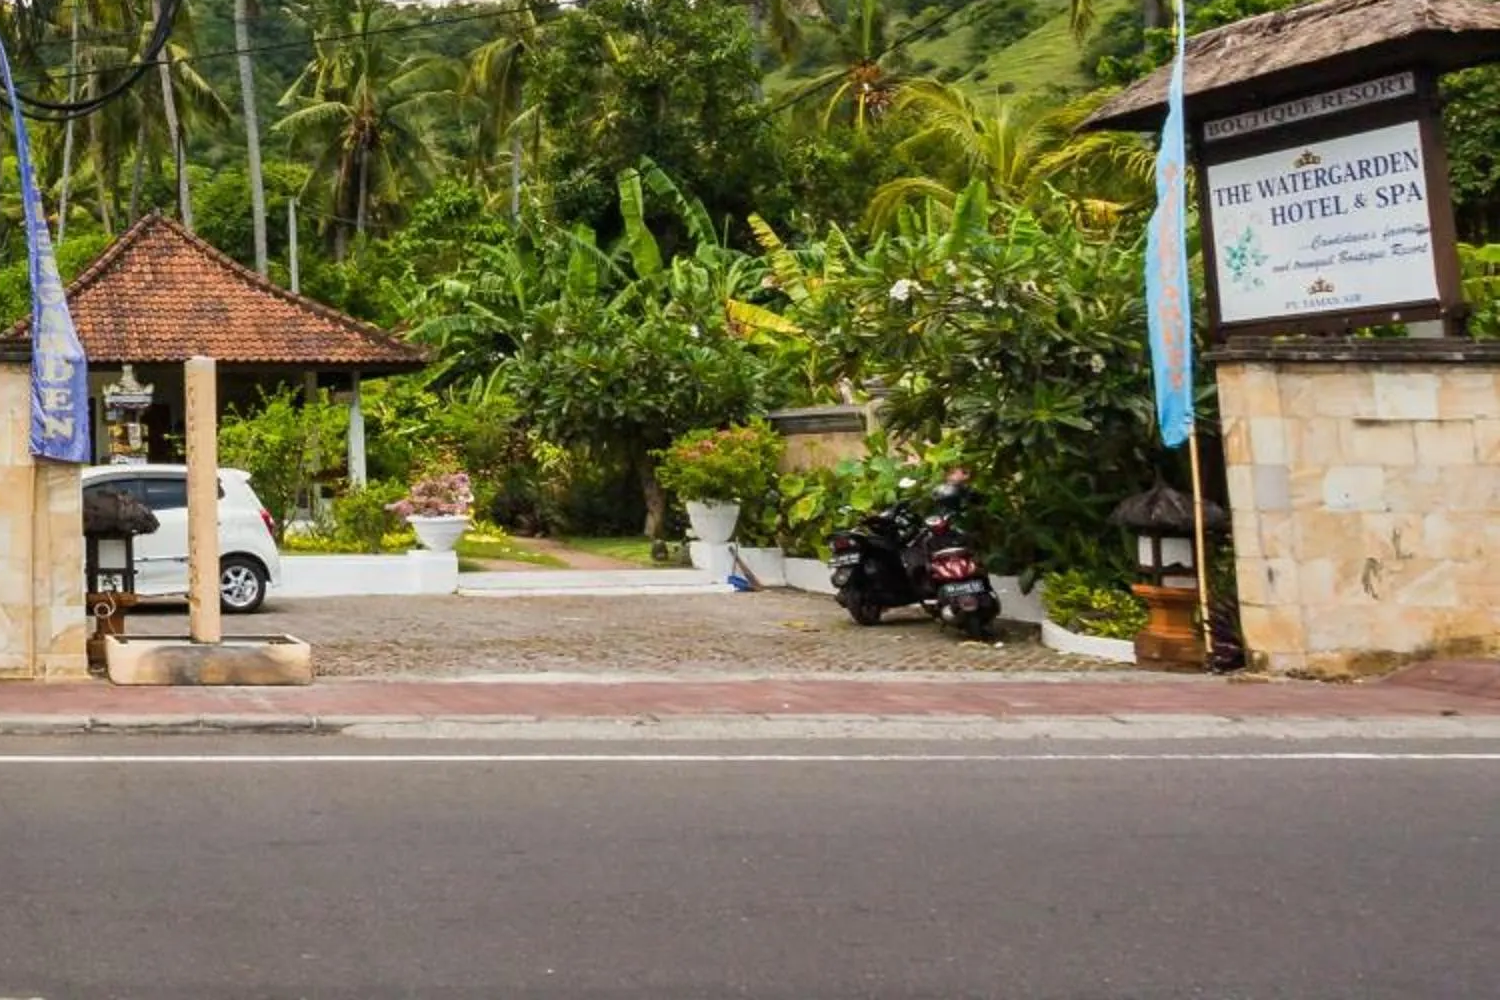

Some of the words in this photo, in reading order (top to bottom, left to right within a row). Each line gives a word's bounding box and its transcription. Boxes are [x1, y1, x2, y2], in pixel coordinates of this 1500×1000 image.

[1207, 100, 1313, 139] BOUTIQUE
[1320, 75, 1411, 110] RESORT
[1213, 182, 1253, 207] THE
[1256, 148, 1419, 199] WATERGARDEN
[1270, 195, 1348, 226] HOTEL
[1353, 193, 1368, 209] &
[1375, 180, 1423, 209] SPA
